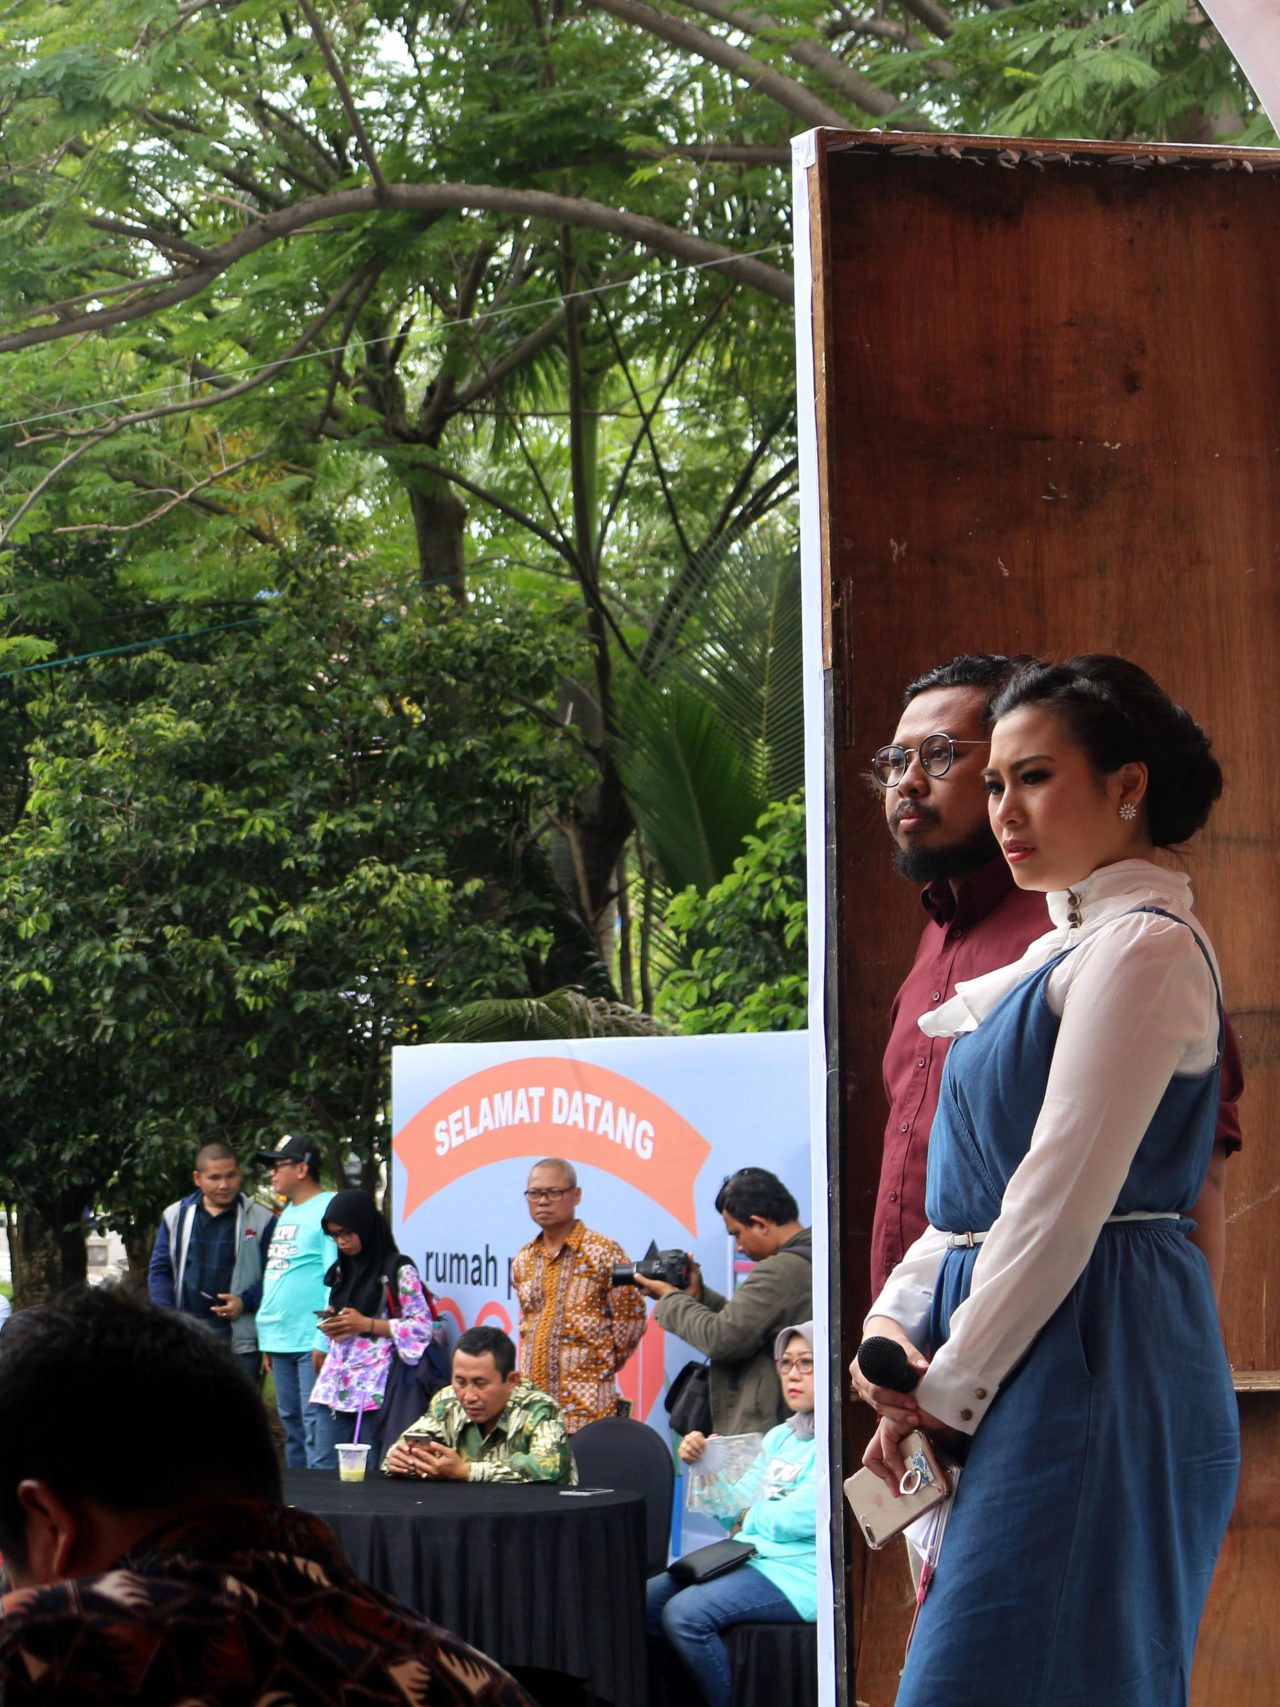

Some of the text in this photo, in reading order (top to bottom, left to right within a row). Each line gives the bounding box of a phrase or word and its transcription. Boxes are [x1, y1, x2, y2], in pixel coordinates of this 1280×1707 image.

[434, 1086, 655, 1160] SELAMAT DATANG
[426, 1243, 498, 1287] rumah
